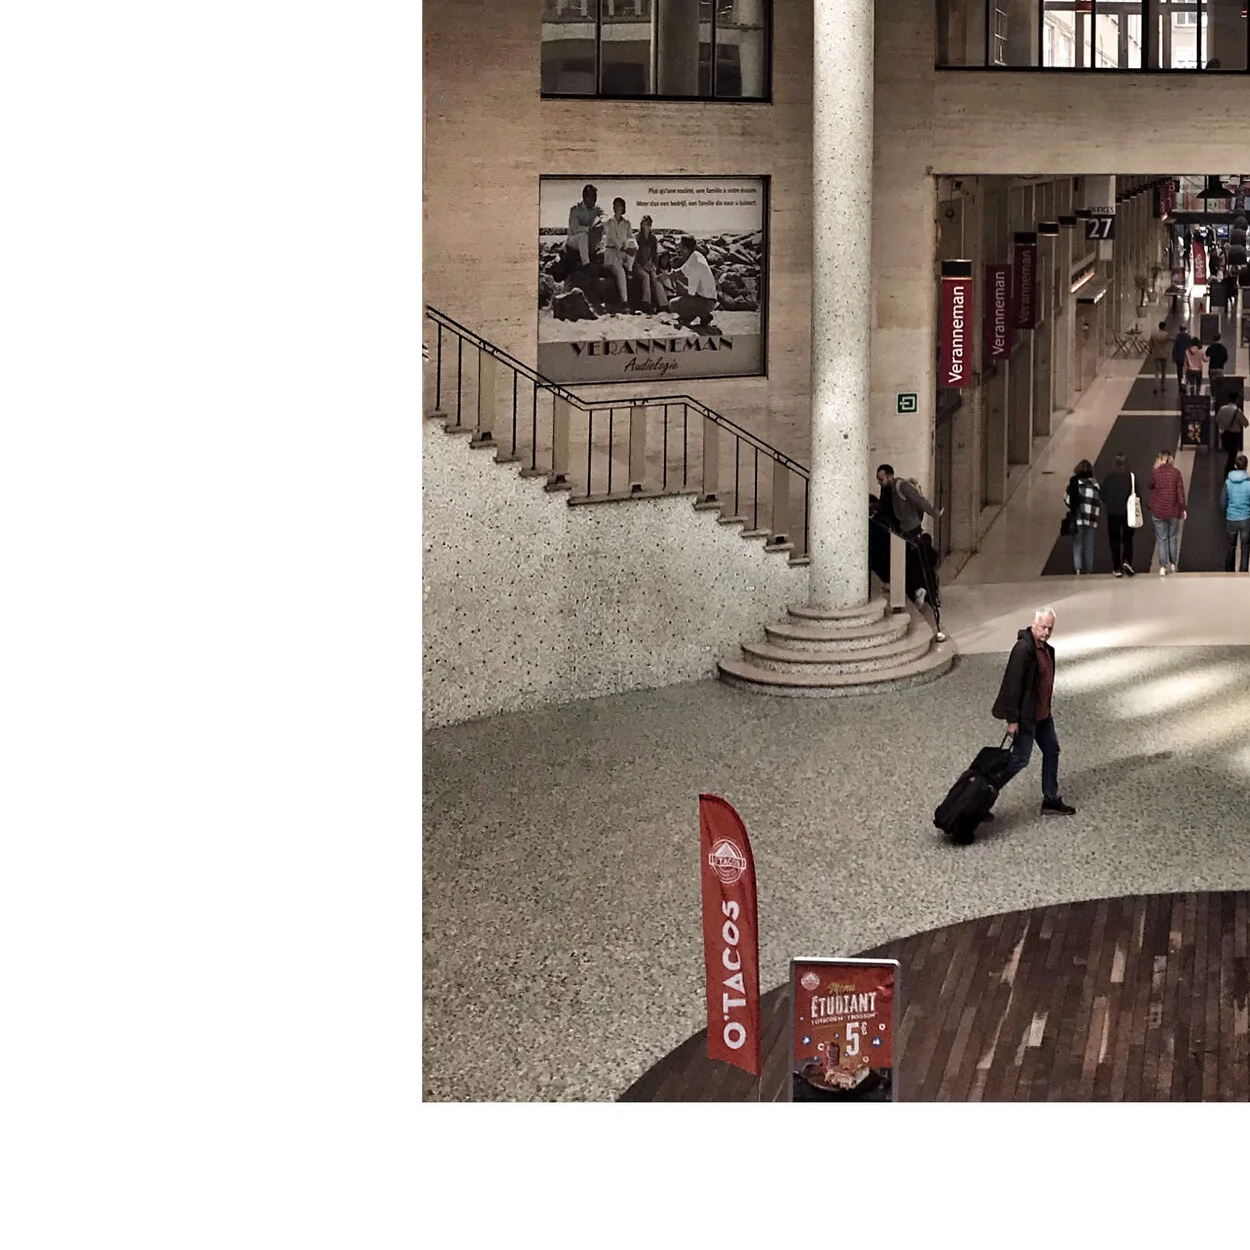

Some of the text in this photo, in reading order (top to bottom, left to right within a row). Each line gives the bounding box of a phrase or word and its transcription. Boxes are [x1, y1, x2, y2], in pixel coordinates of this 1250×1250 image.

[1089, 218, 1113, 238] 27
[992, 271, 1005, 355] Veranneman
[1018, 250, 1032, 324] Veranneman
[571, 336, 733, 357] VERANNEMAN
[623, 356, 679, 376] Audiologie
[948, 285, 964, 383] Veranneman
[721, 900, 747, 1050] O'TACOS
